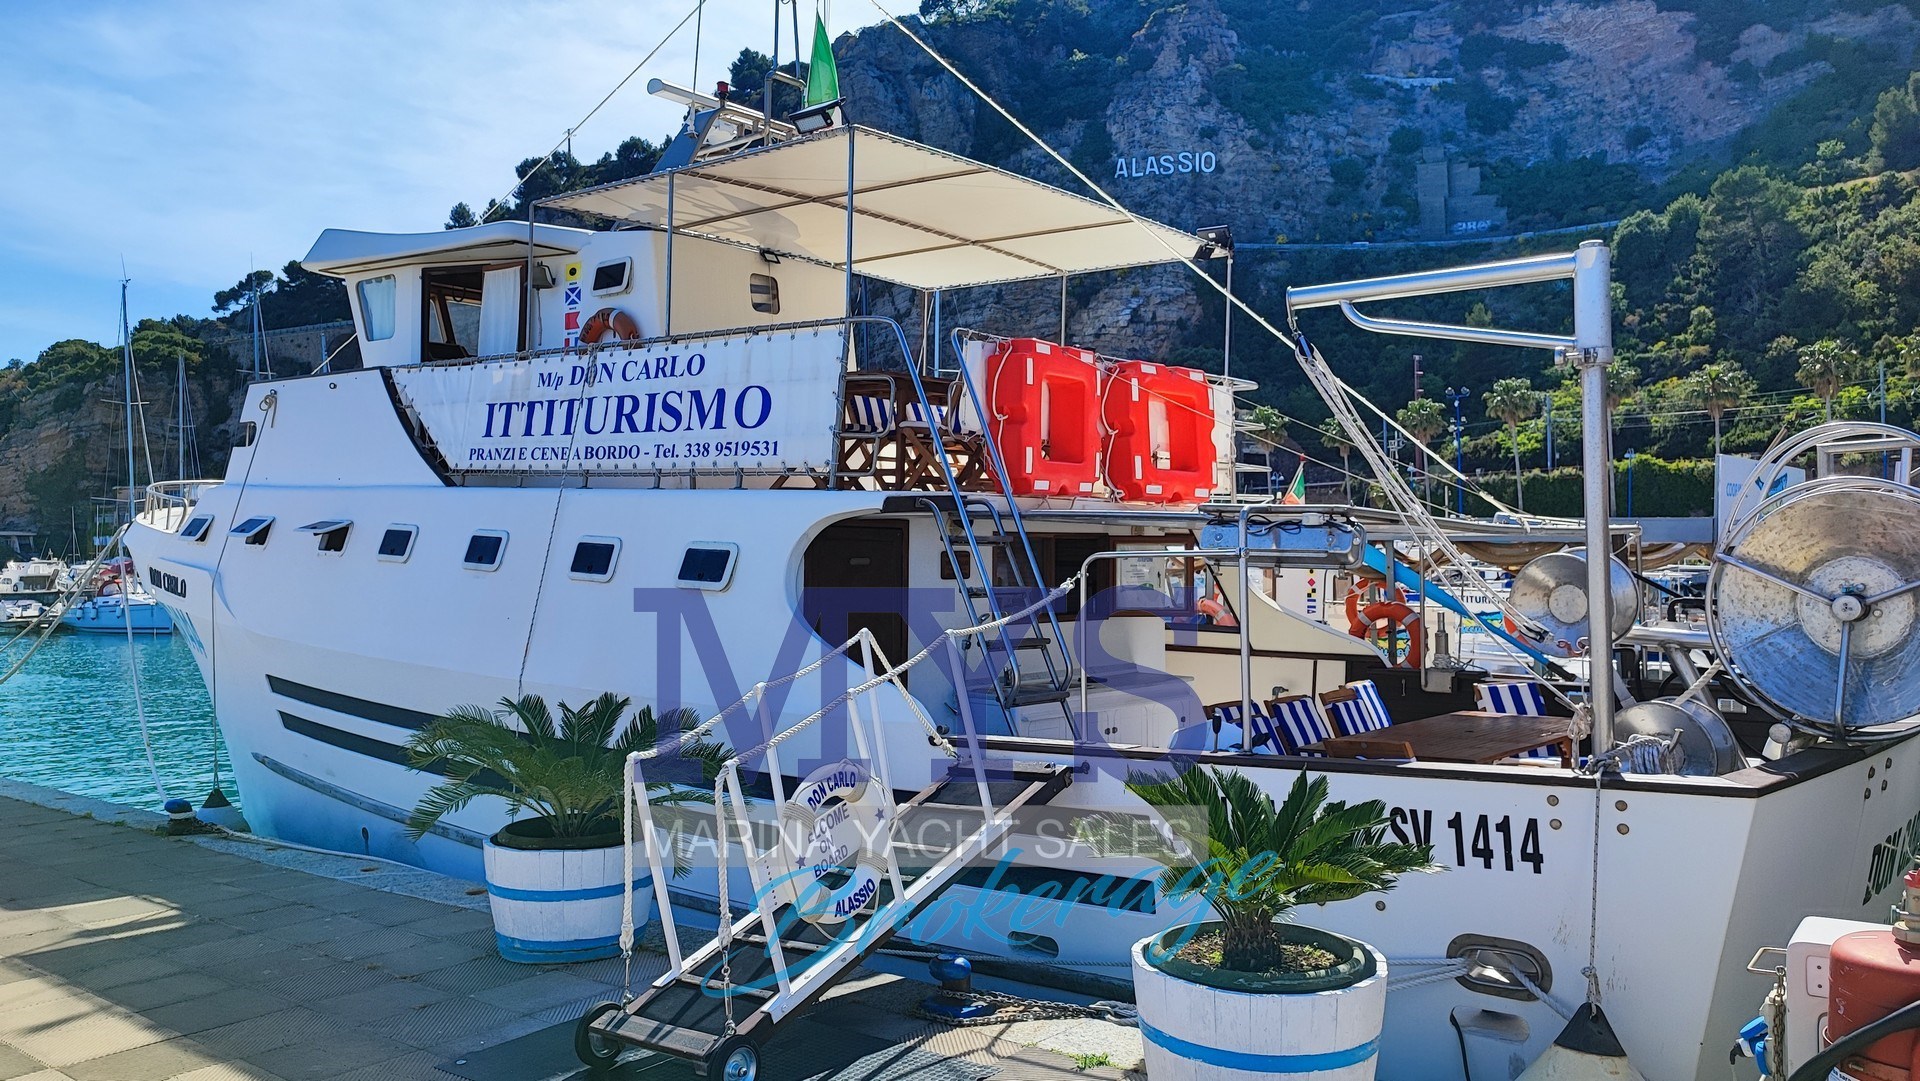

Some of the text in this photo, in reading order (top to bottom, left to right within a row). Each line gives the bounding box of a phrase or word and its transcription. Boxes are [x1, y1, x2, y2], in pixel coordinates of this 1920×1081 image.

[1114, 151, 1216, 178] ALASSIO
[537, 353, 706, 391] M/p DON CARLO
[482, 385, 772, 438] ITTITURISMO
[469, 447, 516, 461] PRANZI
[518, 447, 528, 461] E
[531, 446, 570, 461] CENE
[572, 445, 581, 460] A
[584, 444, 640, 460] BORDO
[654, 443, 679, 458] Tel.
[684, 442, 710, 458] 338
[715, 440, 778, 457] 9519531
[807, 771, 856, 812] DON CARLO
[808, 802, 850, 844] ELCOME
[1447, 811, 1544, 874] 1414
[813, 844, 849, 879] BOARD
[820, 834, 835, 854] ON
[834, 877, 876, 918] ALASSIO
